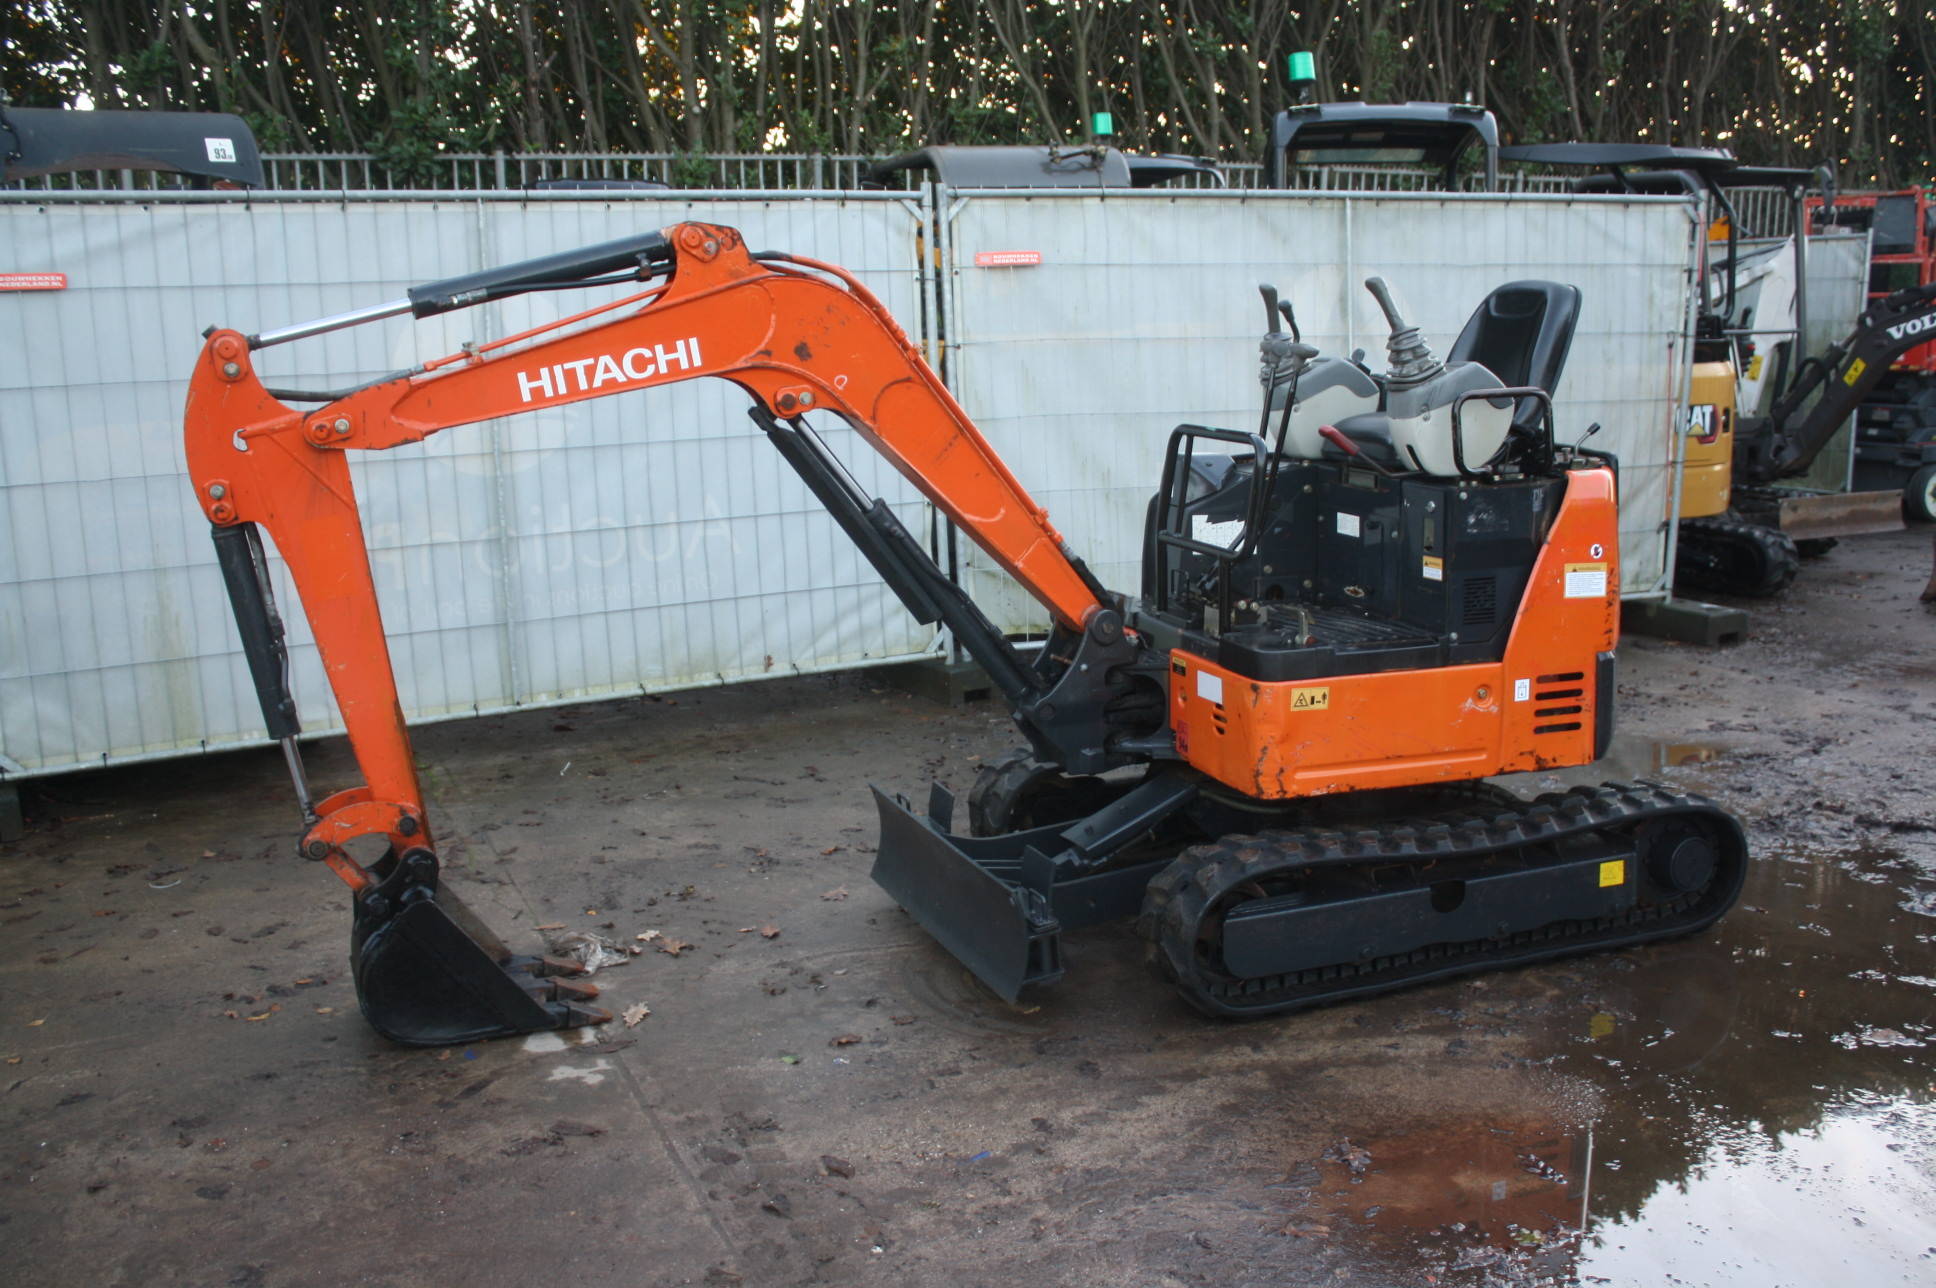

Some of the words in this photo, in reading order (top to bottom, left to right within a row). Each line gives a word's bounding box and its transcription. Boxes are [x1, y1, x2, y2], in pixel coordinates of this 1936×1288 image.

[214, 147, 227, 159] 93
[1886, 312, 1936, 340] VOL
[517, 337, 702, 403] HITACHI
